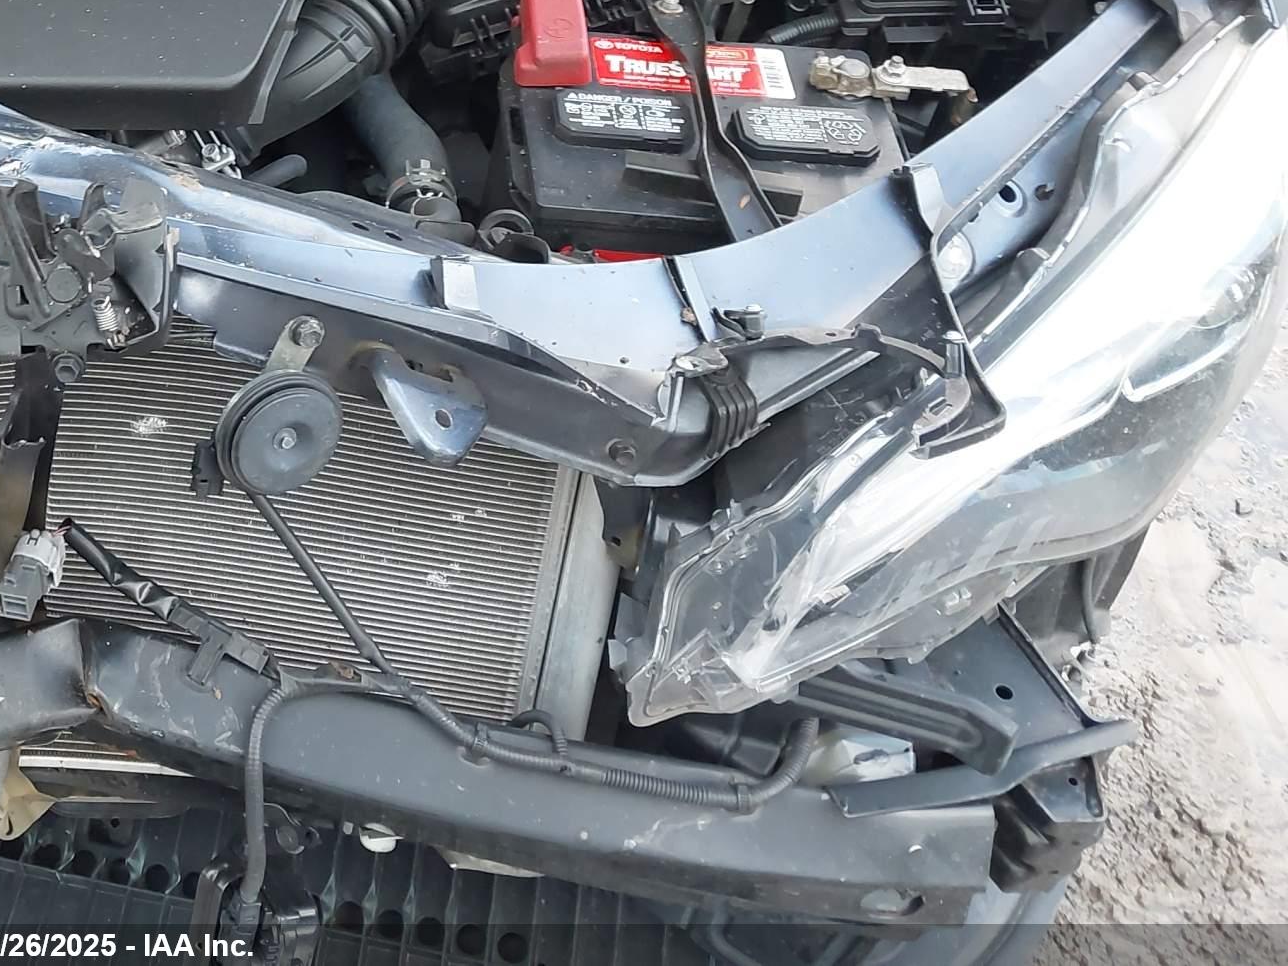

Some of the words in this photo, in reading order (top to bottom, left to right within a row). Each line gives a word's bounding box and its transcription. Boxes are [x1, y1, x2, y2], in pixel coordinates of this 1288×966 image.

[614, 42, 664, 54] TOYOTA
[604, 54, 751, 83] TRUESART
[578, 92, 622, 104] DANGER
[631, 97, 672, 106] POISON
